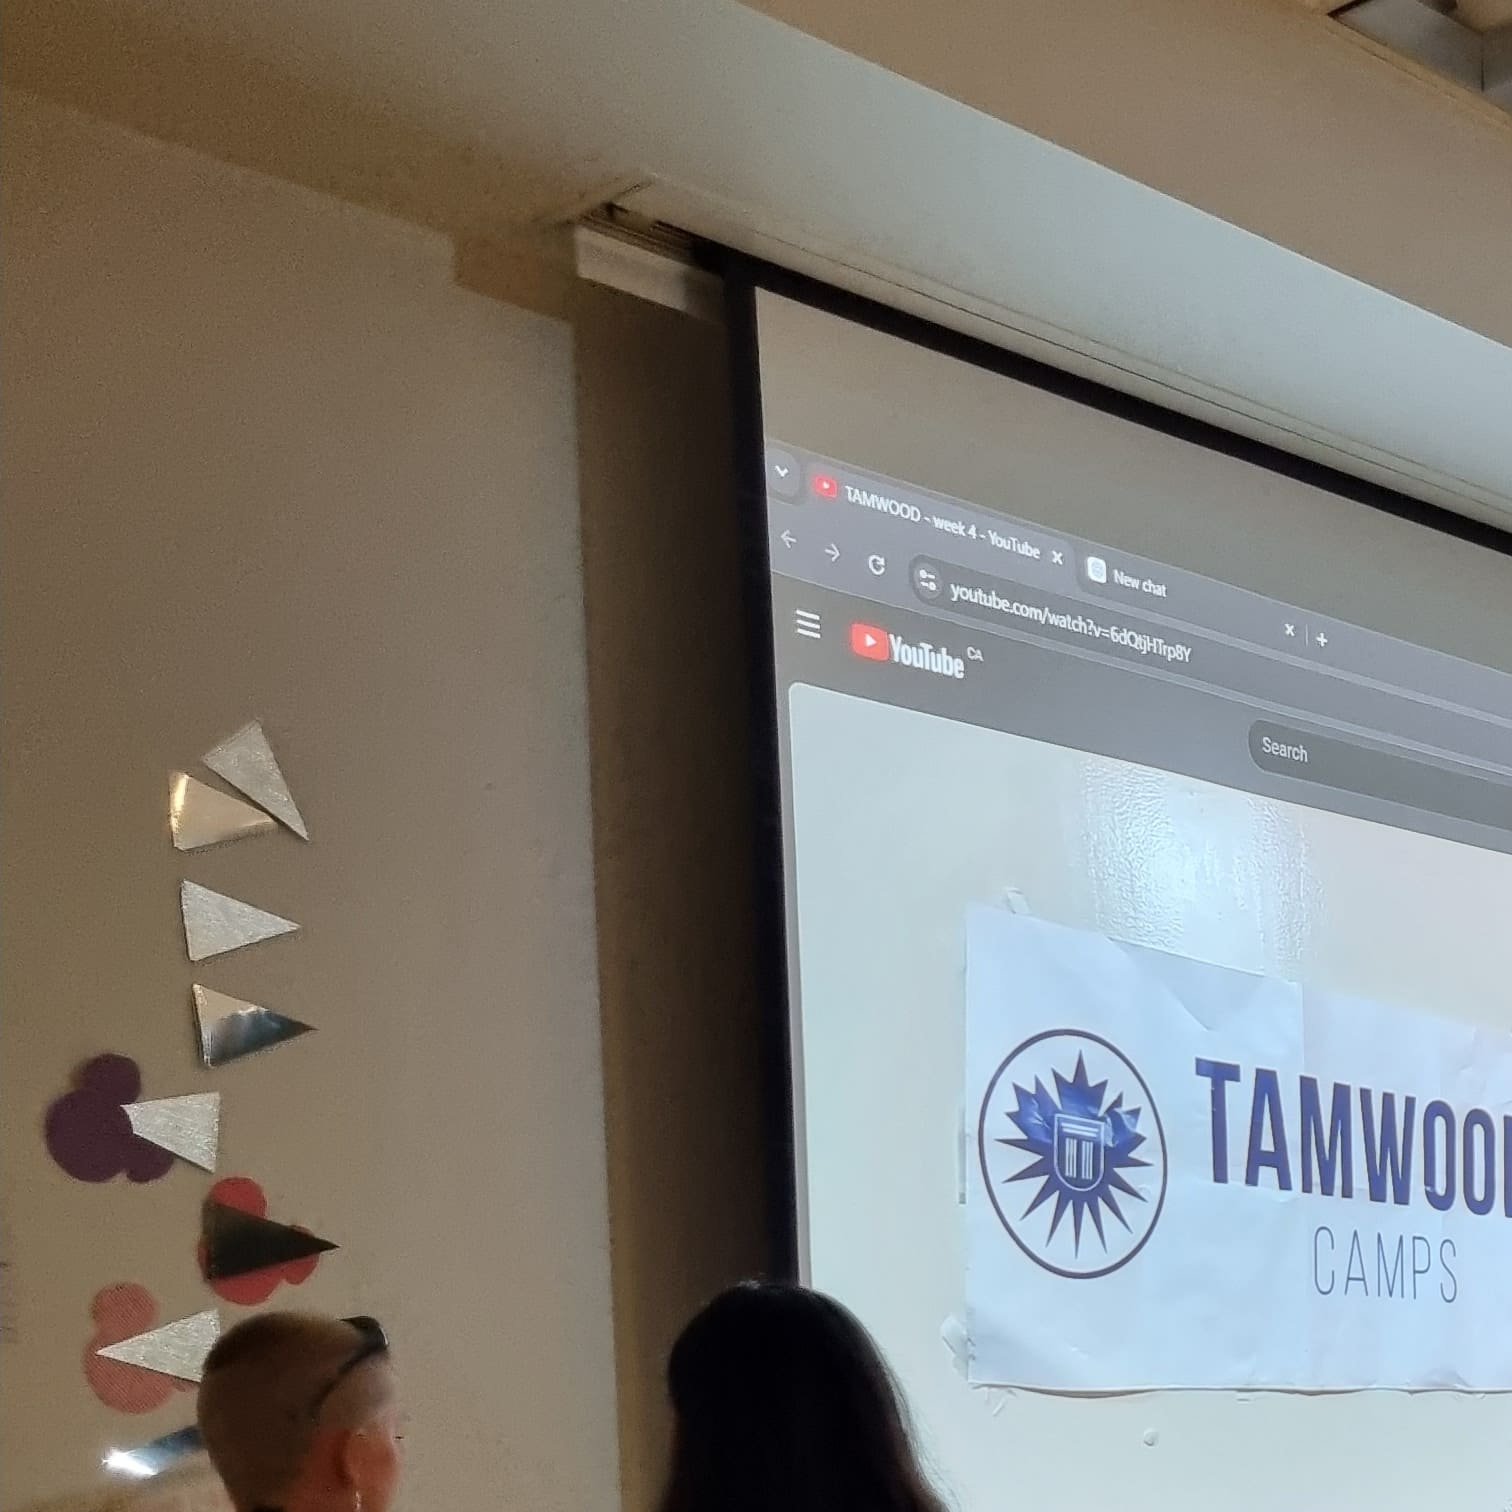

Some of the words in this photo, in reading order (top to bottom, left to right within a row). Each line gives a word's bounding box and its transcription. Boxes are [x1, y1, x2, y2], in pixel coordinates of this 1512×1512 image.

[844, 485, 921, 522] TAMWOOD
[933, 516, 966, 537] week
[968, 524, 977, 540] 4
[987, 530, 1041, 559] YouTube
[1113, 569, 1140, 590] New
[1142, 579, 1168, 598] chat
[888, 633, 965, 679] YouTube
[966, 646, 984, 661] CA
[1262, 736, 1308, 762] Search
[1314, 1226, 1458, 1303] CAMPS
